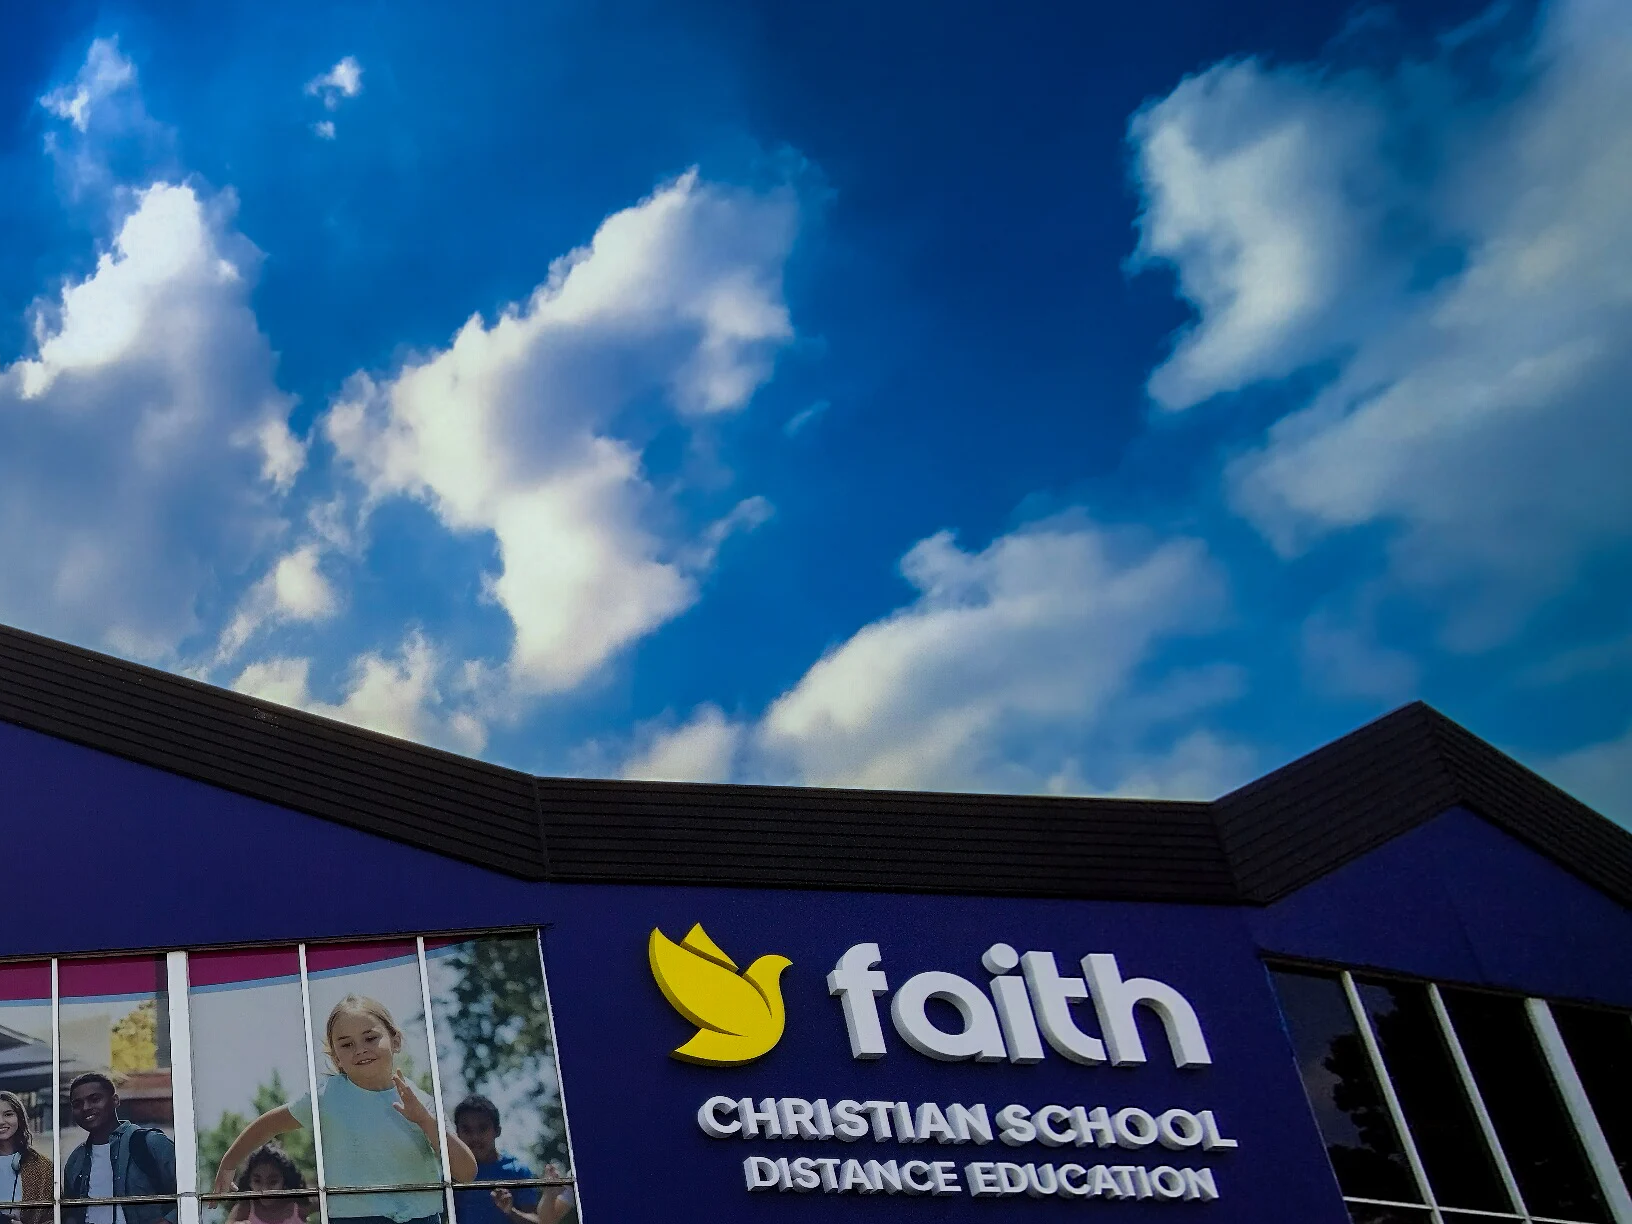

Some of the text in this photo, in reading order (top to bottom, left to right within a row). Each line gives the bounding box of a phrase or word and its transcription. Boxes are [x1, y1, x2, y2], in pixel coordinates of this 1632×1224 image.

[827, 943, 1212, 1068] faith
[697, 1095, 1239, 1151] CHRISTIAN SCHOOL
[743, 1156, 1220, 1200] DISTANCE EDUCATION
